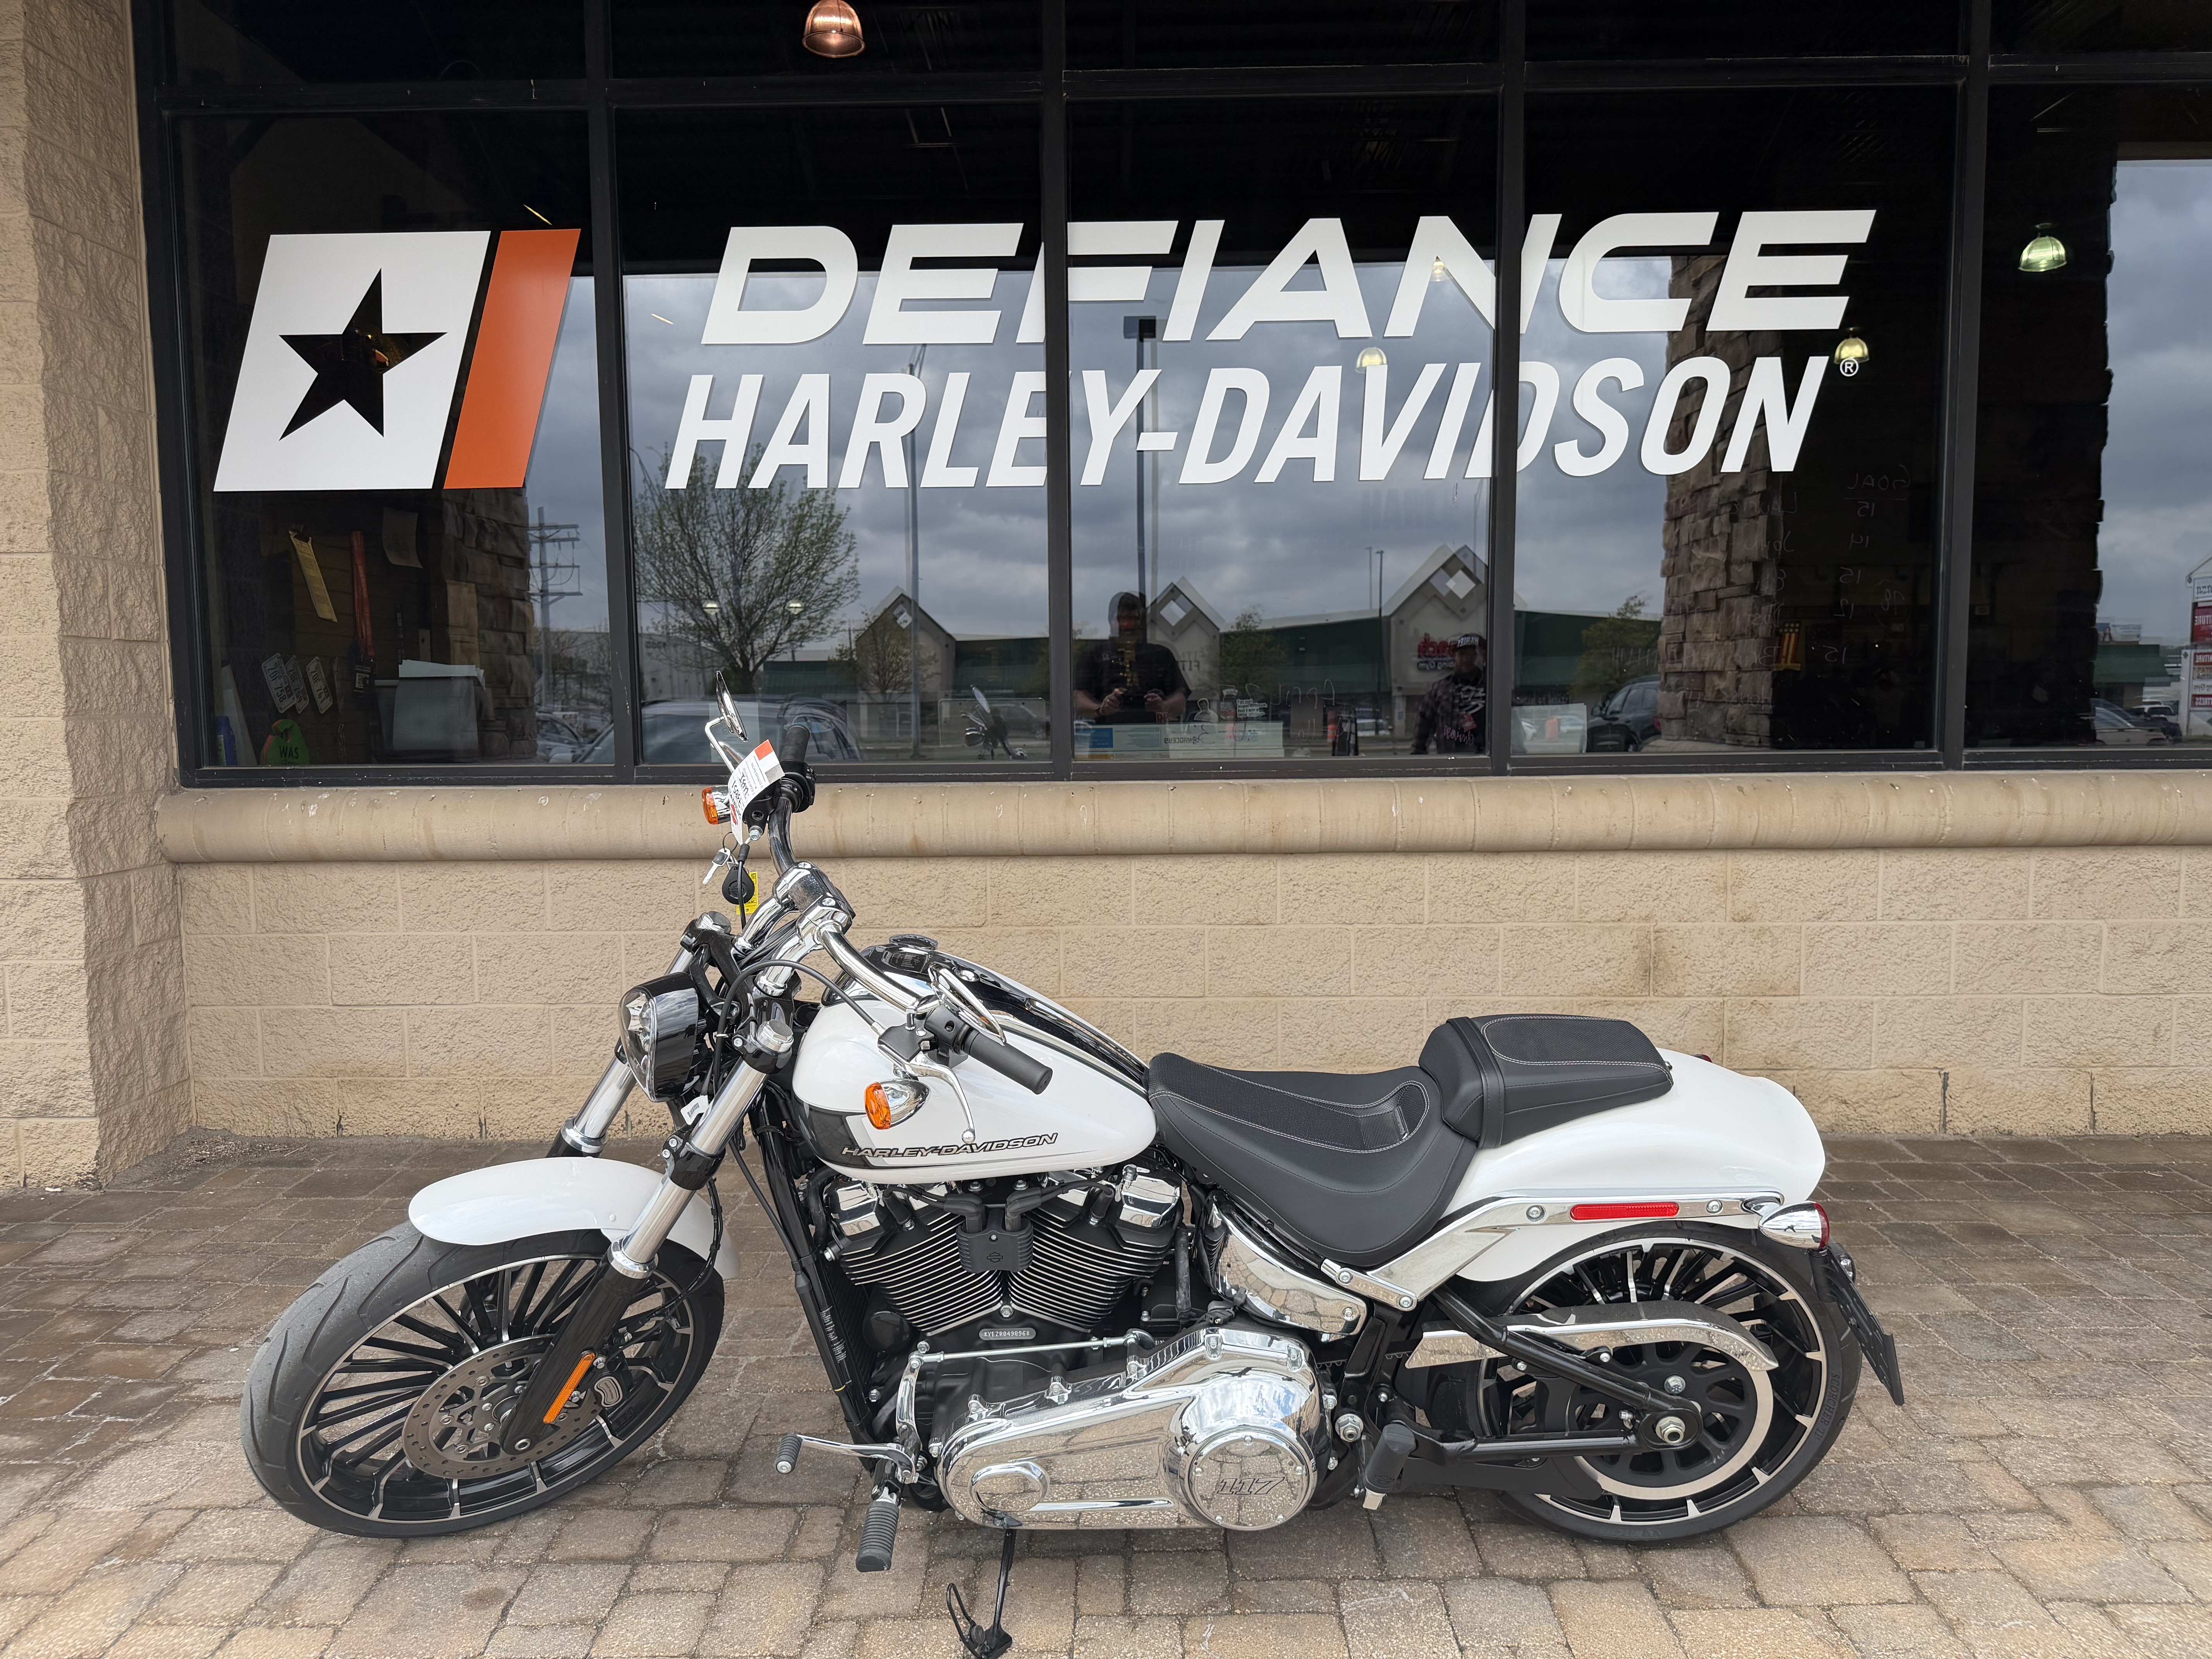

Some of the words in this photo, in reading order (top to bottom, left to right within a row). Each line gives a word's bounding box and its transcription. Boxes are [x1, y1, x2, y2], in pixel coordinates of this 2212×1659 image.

[702, 210, 1877, 344] DEFIANCE
[665, 356, 1828, 489] HARLEY-DAVIDSON
[279, 746, 299, 759] WAS
[842, 1133, 1058, 1158] HARLEY-DAVIDSON
[1216, 1476, 1286, 1496] 117
